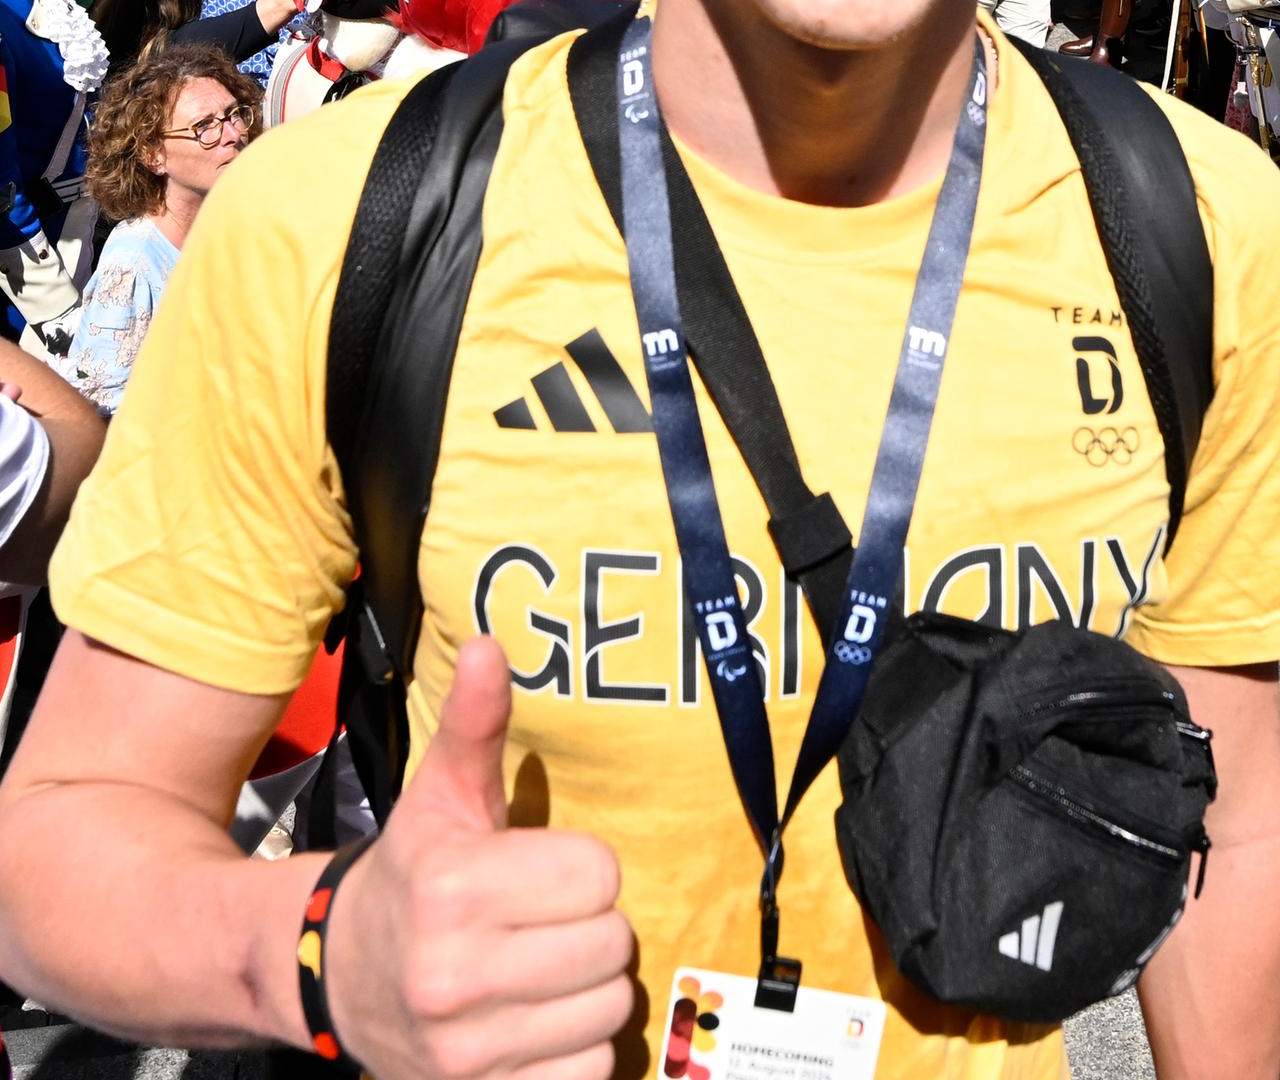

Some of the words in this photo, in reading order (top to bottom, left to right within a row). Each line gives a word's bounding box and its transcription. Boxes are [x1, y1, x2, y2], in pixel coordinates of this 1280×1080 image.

[1051, 306, 1122, 327] TEAM
[695, 595, 736, 614] TEAM
[850, 589, 888, 609] TEAM
